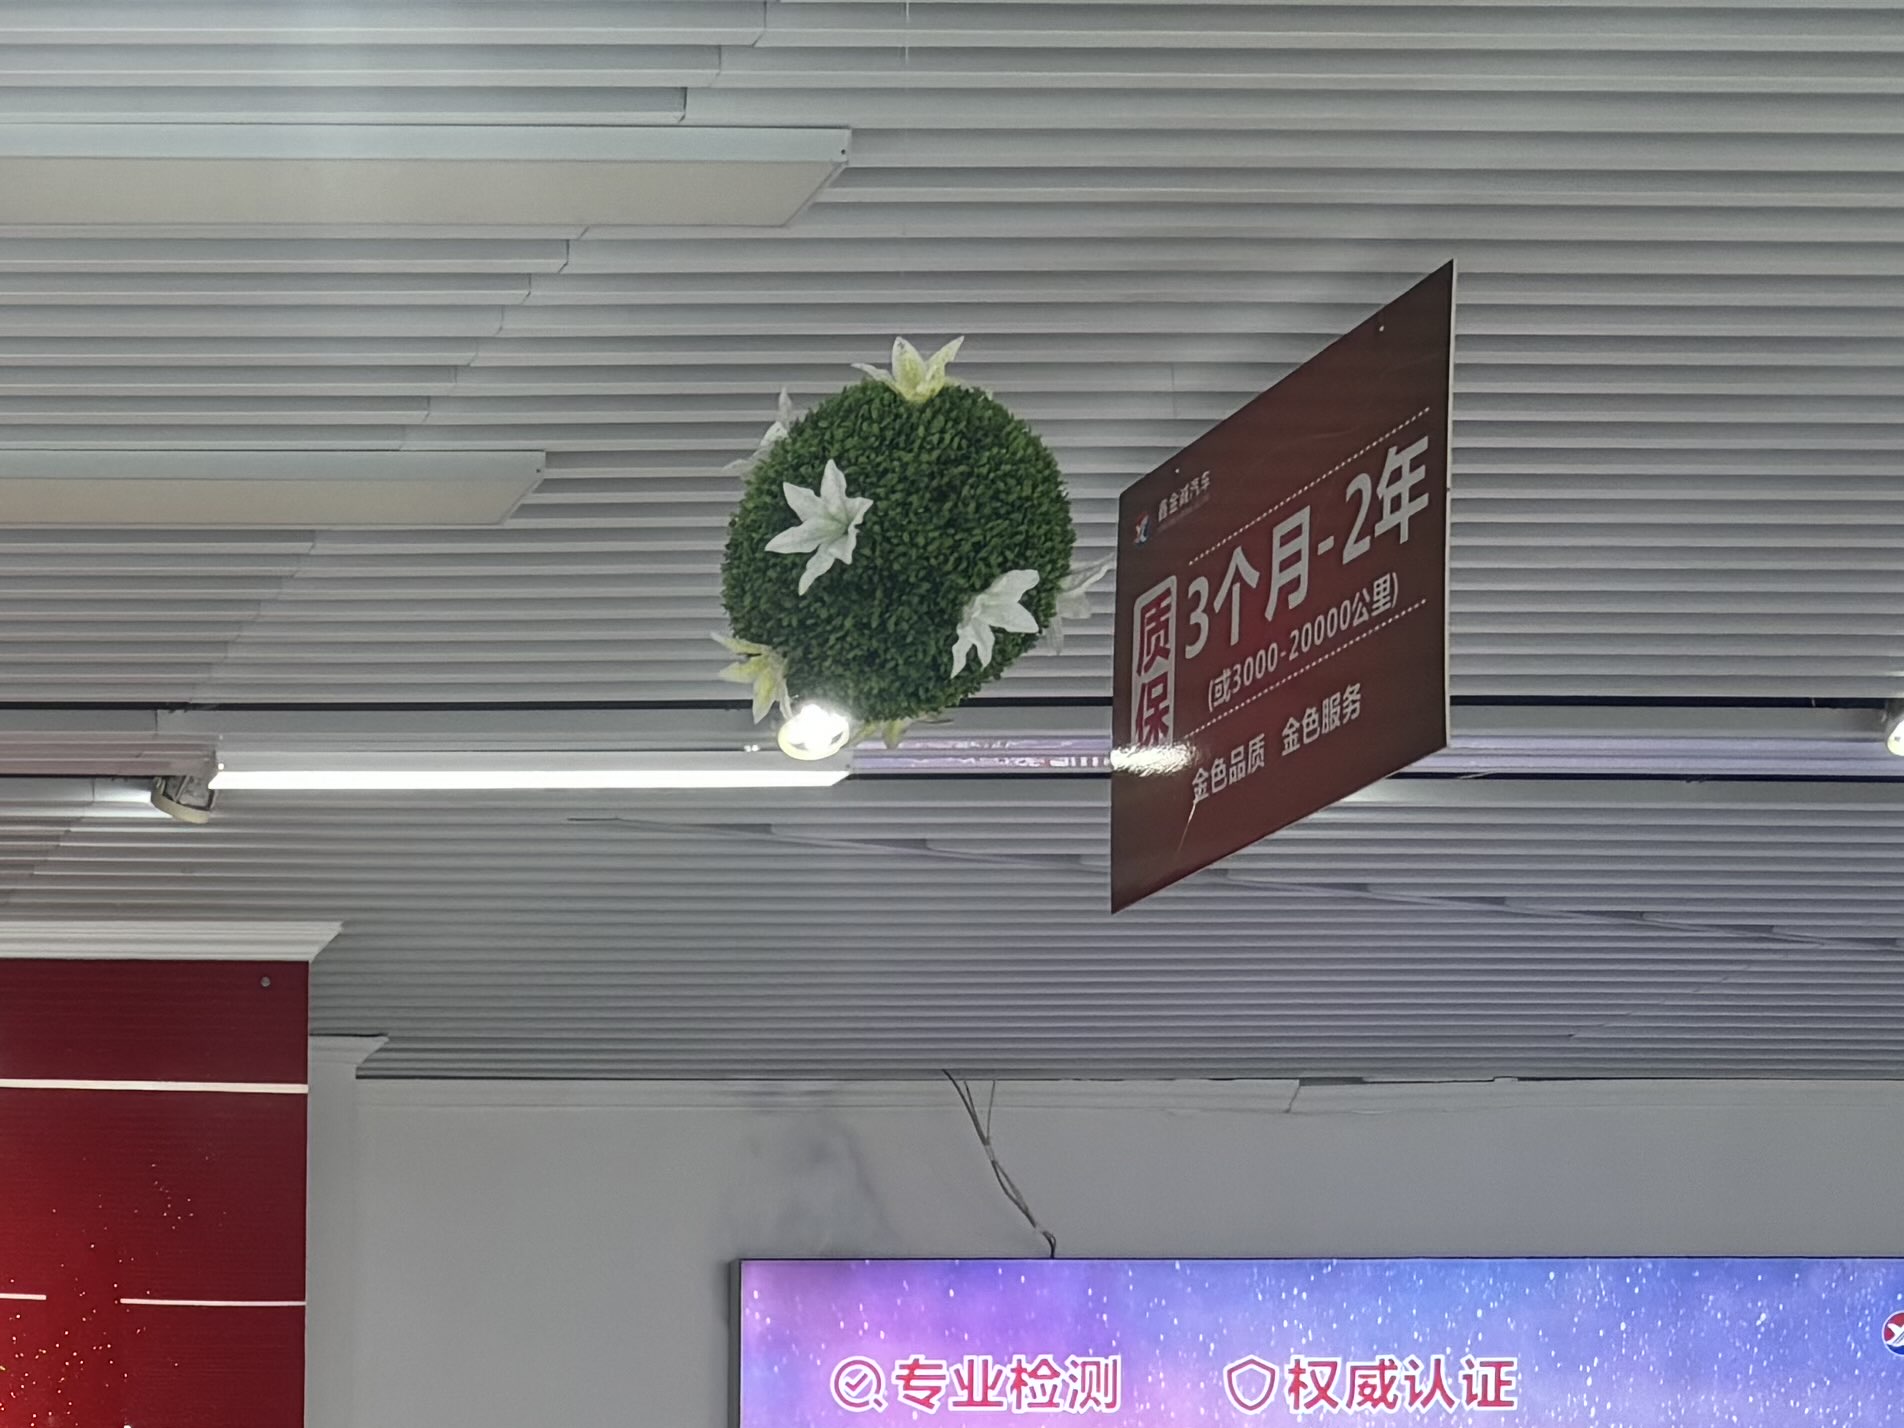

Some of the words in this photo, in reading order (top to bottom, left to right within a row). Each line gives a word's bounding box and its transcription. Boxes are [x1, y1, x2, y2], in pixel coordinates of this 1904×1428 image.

[1185, 434, 1429, 660] 3个月-2年
[1135, 588, 1173, 750] 质保
[1208, 571, 1400, 713] (或3000-20000公里)
[1192, 733, 1266, 804] 金色品质
[1281, 683, 1362, 756] 金色服务
[892, 1354, 1122, 1413] 专业检测
[1284, 1354, 1518, 1415] 权威认证
